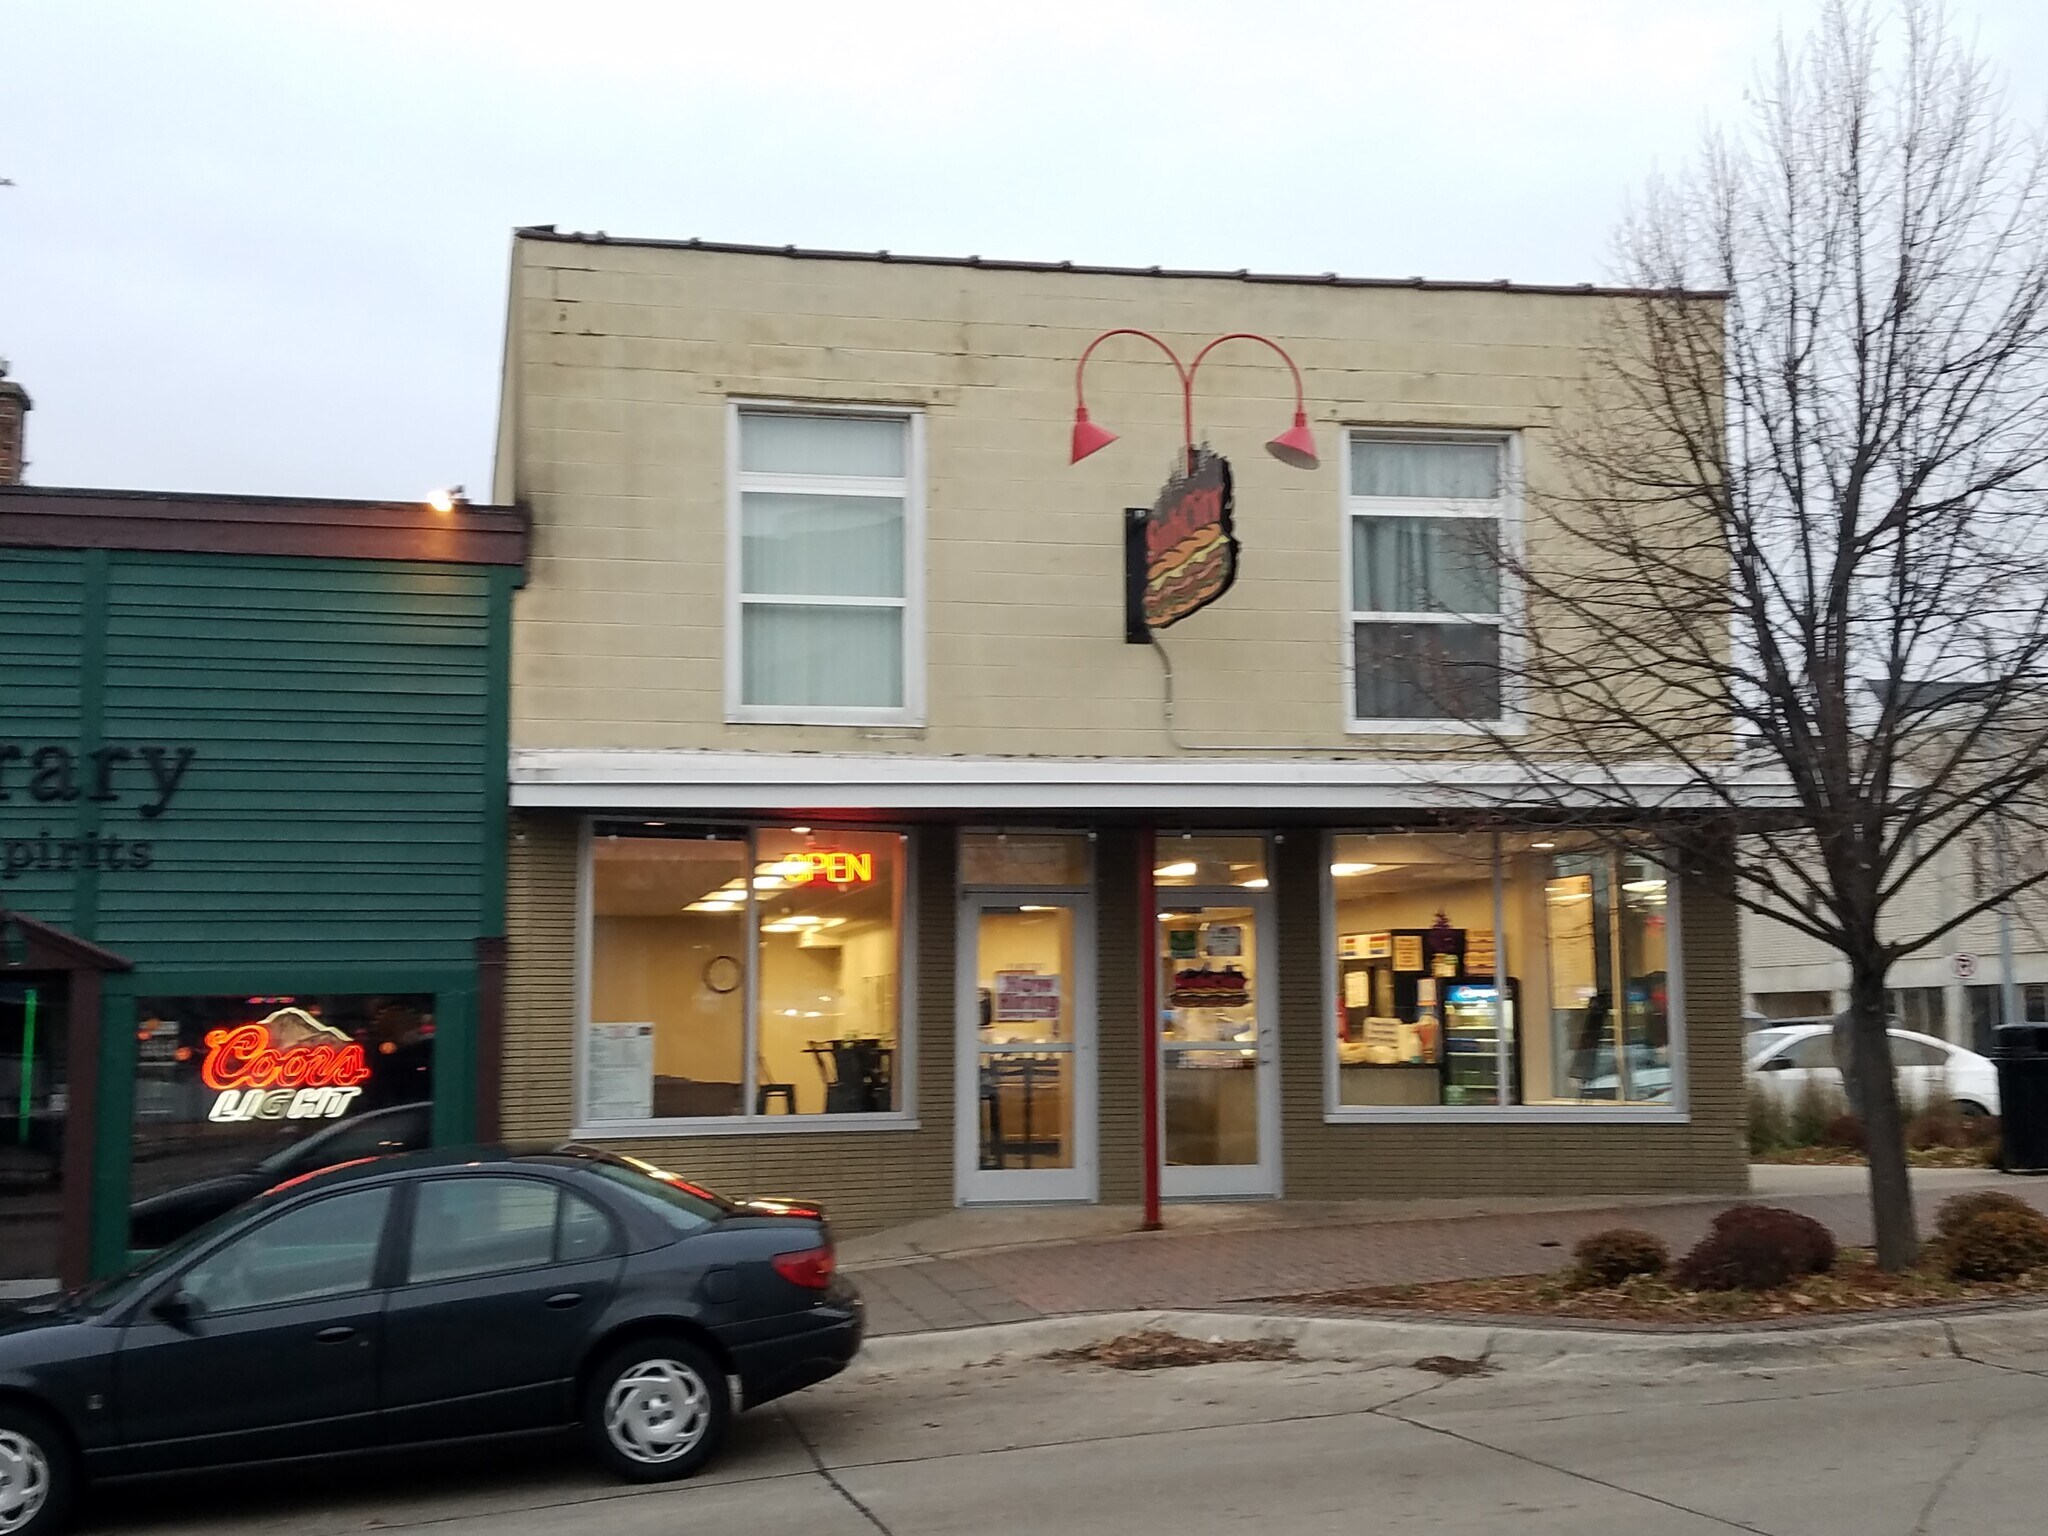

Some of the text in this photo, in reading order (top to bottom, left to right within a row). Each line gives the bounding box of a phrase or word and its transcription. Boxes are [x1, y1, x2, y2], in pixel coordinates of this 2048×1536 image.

[783, 852, 872, 882] OPEN
[201, 1024, 371, 1090] Coors
[207, 1087, 364, 1122] LIGHT
